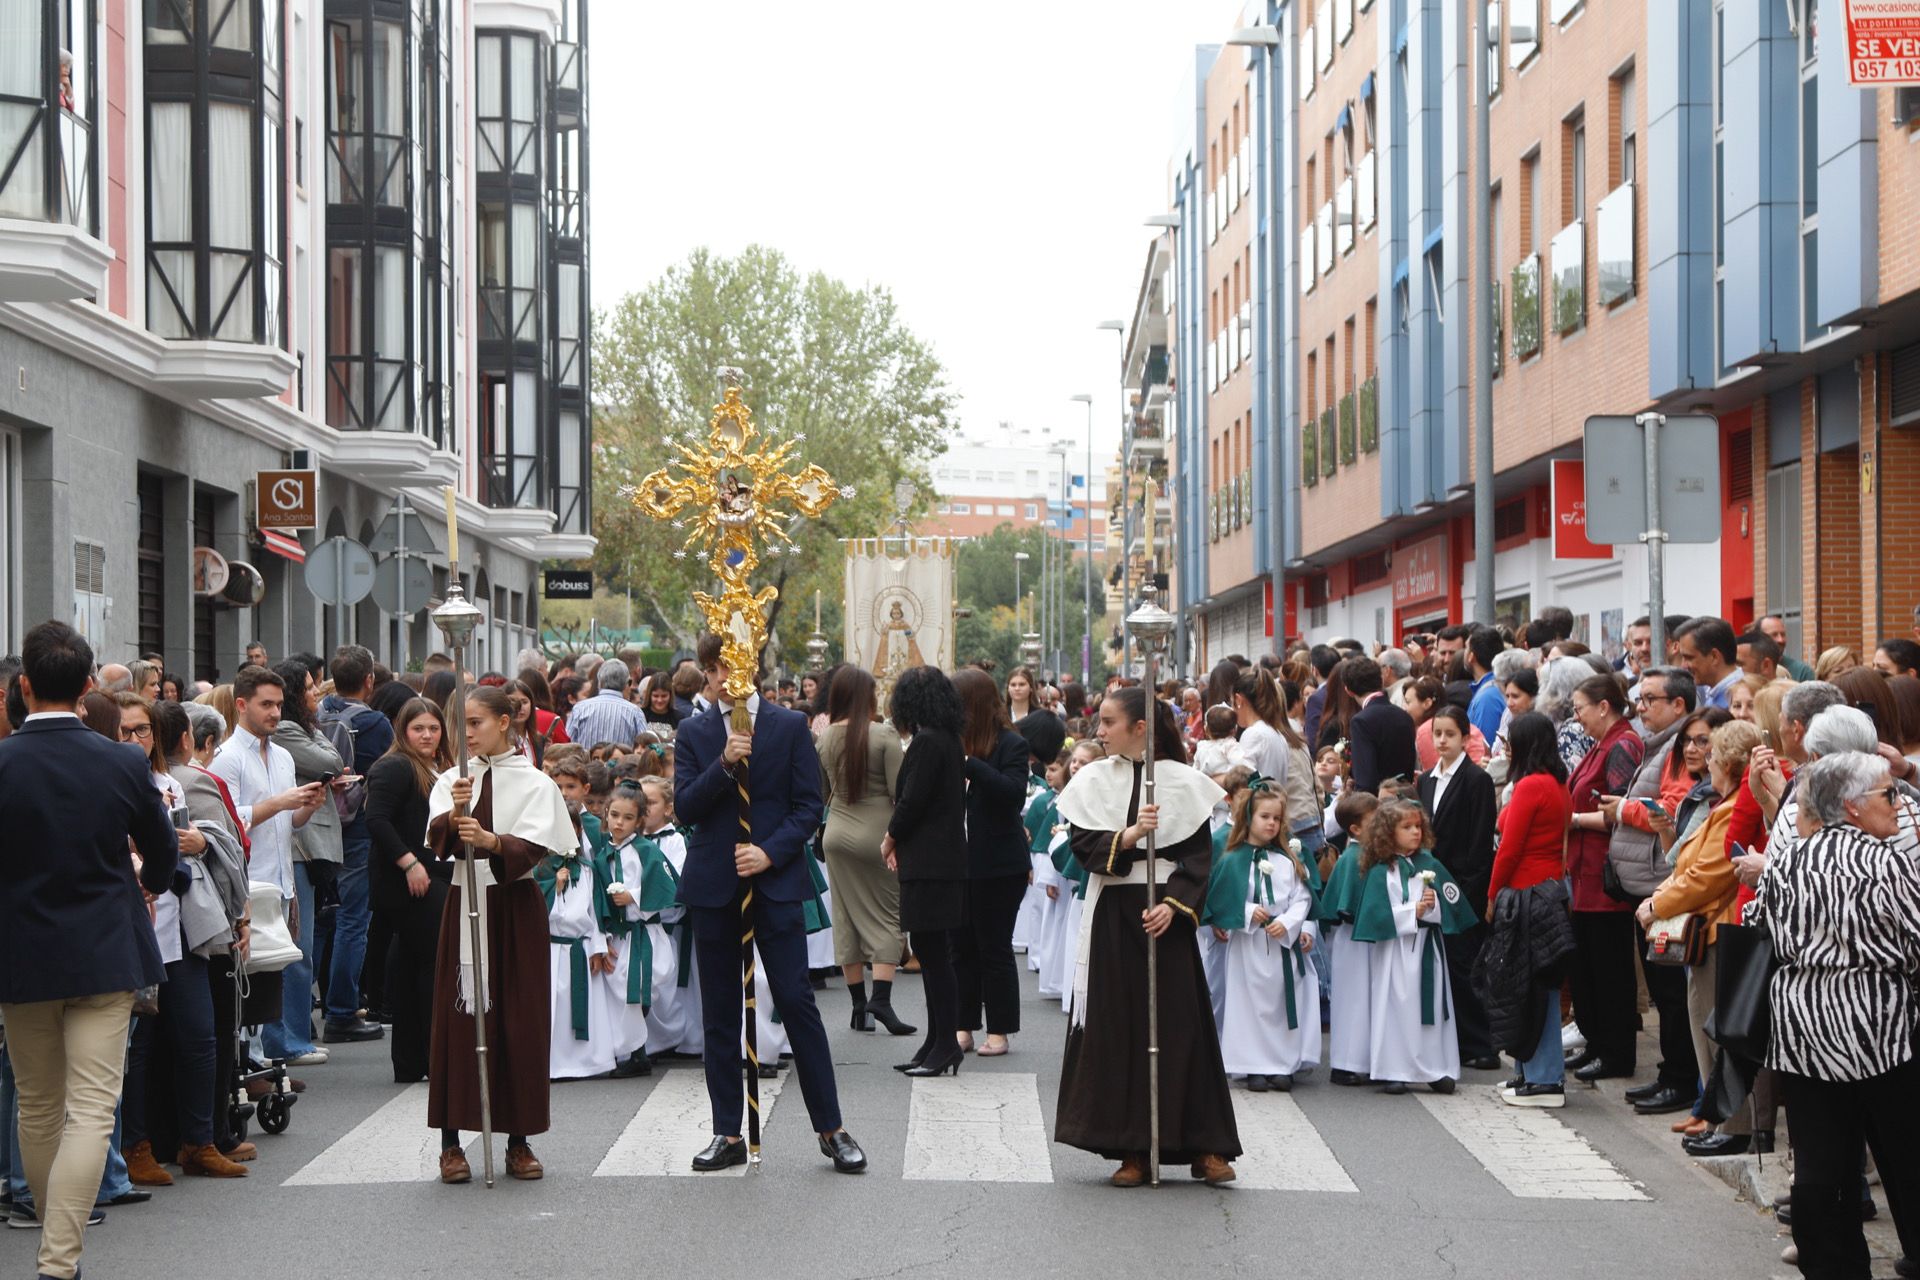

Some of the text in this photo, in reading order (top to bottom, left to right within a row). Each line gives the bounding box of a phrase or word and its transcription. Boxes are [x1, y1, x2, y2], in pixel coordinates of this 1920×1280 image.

[1869, 18, 1897, 28] portal
[1856, 39, 1881, 57] SE
[1858, 61, 1888, 78] 957
[263, 512, 313, 521] Ana Santos
[548, 579, 590, 591] dobuss
